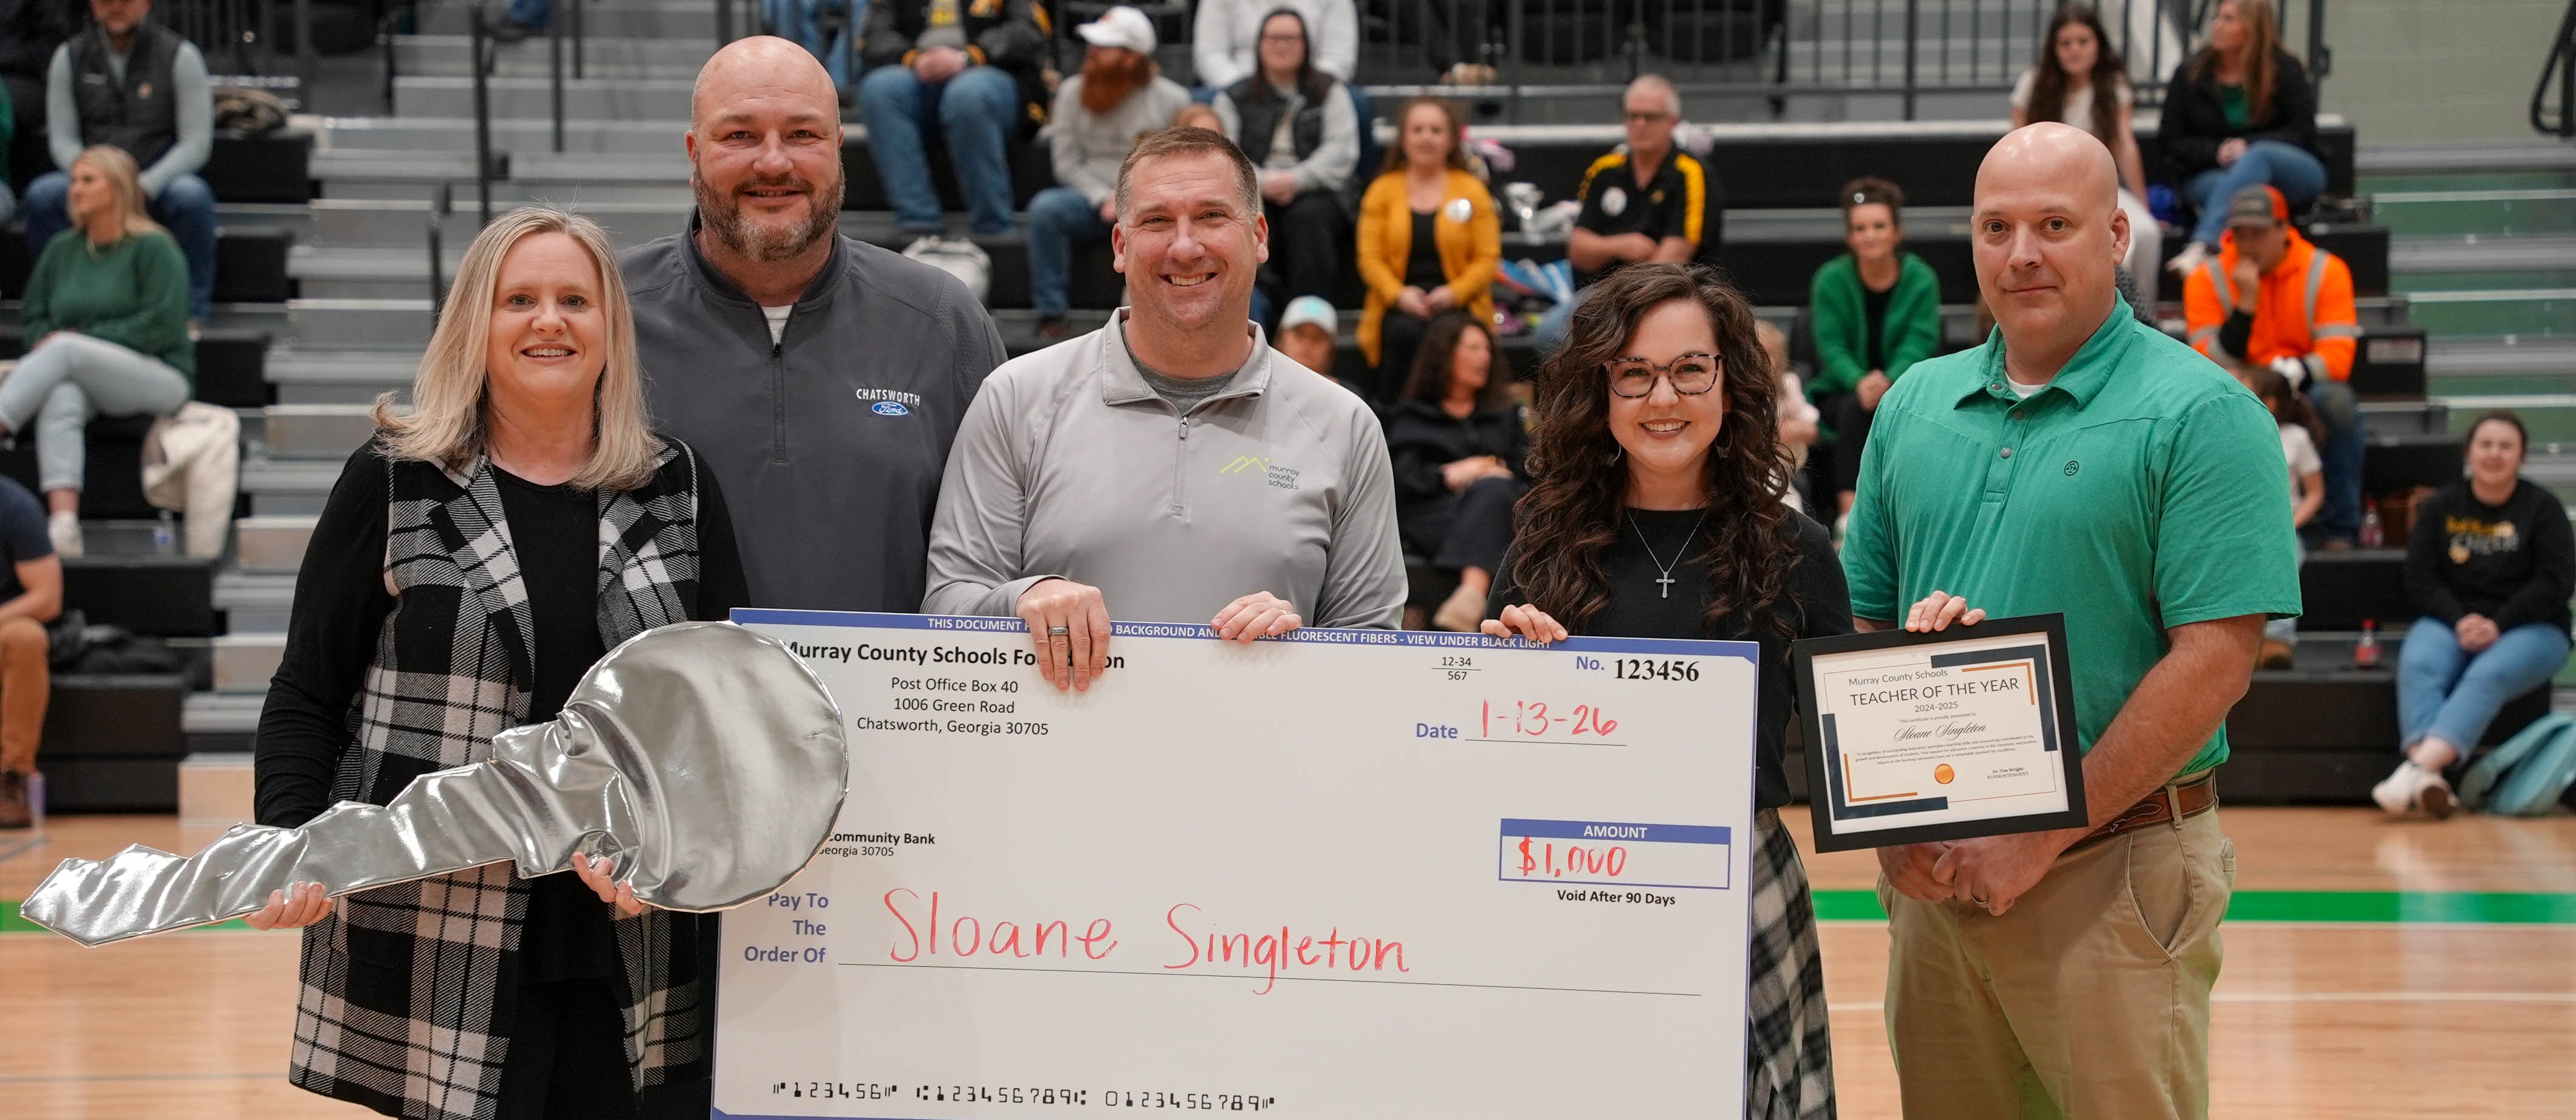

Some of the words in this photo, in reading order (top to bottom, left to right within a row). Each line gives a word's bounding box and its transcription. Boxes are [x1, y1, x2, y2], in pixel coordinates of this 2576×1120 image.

[856, 388, 920, 406] CHATSWORTH
[879, 403, 903, 414] Ford
[1269, 473, 1295, 483] county
[1270, 466, 1300, 476] murray
[1269, 479, 1300, 490] schools
[928, 618, 953, 628] THIS
[956, 619, 1021, 631] DOCUMENT
[1116, 624, 1195, 637] BACKGROUND
[1281, 630, 1357, 642] FLUORESCENT
[1361, 633, 1397, 644] FIBERS
[1407, 635, 1436, 645] VIEW
[1439, 636, 1479, 647] UNDER
[1481, 638, 1516, 648] BLACK
[857, 644, 928, 665] County
[933, 646, 1007, 666] Schools
[1442, 657, 1471, 667] 12-34
[1448, 671, 1467, 680] 567
[1576, 656, 1604, 670] No.
[1614, 659, 1700, 681] 123456
[891, 677, 921, 690] Post
[926, 678, 967, 692] Office
[972, 680, 997, 692] Box
[1001, 681, 1018, 693] 40
[1849, 678, 1880, 686] Murray
[1882, 673, 1913, 683] County
[1916, 669, 1948, 679] Schools
[1850, 689, 1919, 706] TEACHER
[1923, 685, 1943, 699] OF
[1947, 682, 1976, 696] THE
[1980, 678, 2020, 693] YEAR
[894, 698, 928, 710] 1006
[933, 699, 975, 712] Green
[981, 701, 1015, 713] Road
[1914, 701, 1959, 713] 2024-2025
[857, 717, 942, 733] Chatsworth,
[947, 720, 1001, 736] Georgia
[1005, 722, 1049, 735] 30705
[1482, 699, 1619, 738] 1-13-26
[1416, 723, 1458, 739] Date
[1894, 725, 1932, 742] Sloane
[1936, 721, 1987, 741] Singleton
[904, 833, 935, 844] Bank
[1583, 825, 1647, 839] AMOUNT
[820, 847, 858, 857] eorgia
[861, 847, 894, 856] 30705
[1516, 835, 1626, 878] $1,000
[769, 893, 801, 911] Pay
[806, 893, 829, 908] To
[1557, 890, 1586, 902] Void
[1590, 892, 1622, 903] After
[1626, 892, 1642, 904] 90
[1645, 893, 1676, 907] Days
[793, 919, 826, 935] The
[884, 888, 1118, 962] Sloane
[1164, 904, 1410, 995] Singleton
[744, 946, 799, 963] Order
[803, 947, 826, 963] Of
